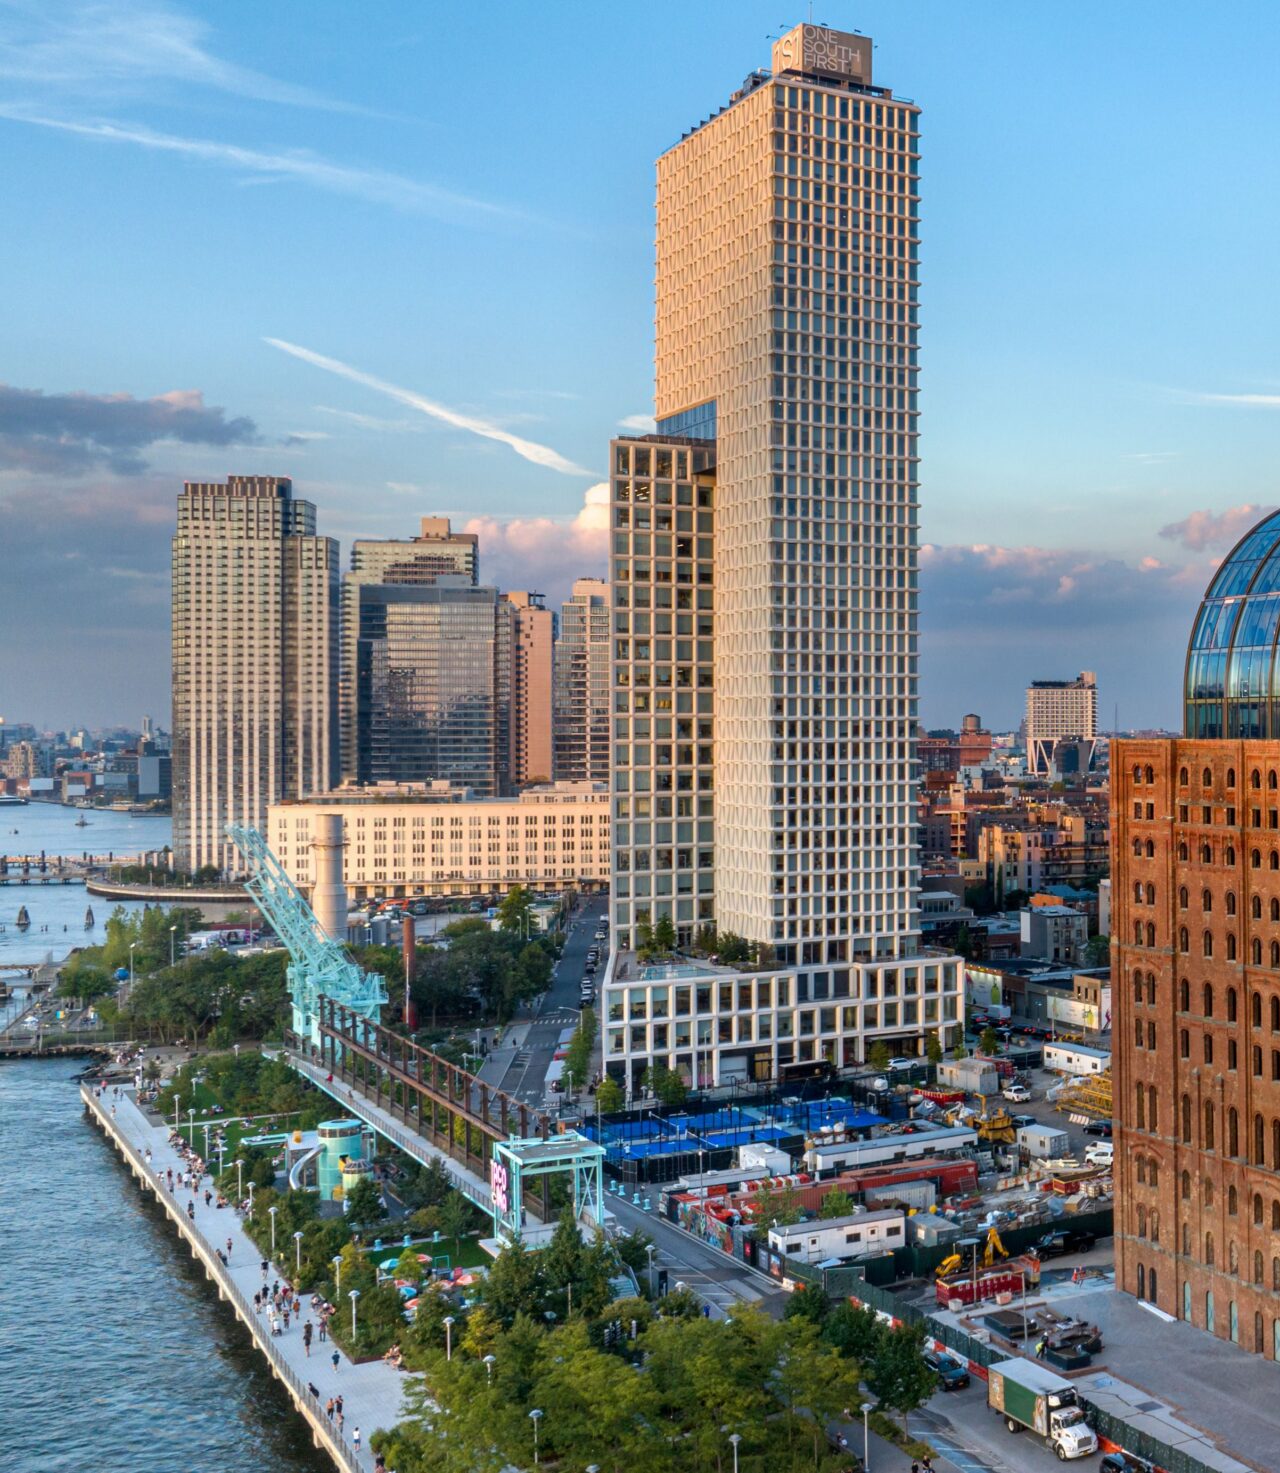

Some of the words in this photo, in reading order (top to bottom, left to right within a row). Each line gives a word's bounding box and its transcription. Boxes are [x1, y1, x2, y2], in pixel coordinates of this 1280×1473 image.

[804, 25, 838, 44] ONE
[804, 39, 860, 62] SOUTH
[804, 53, 849, 73] FIRST
